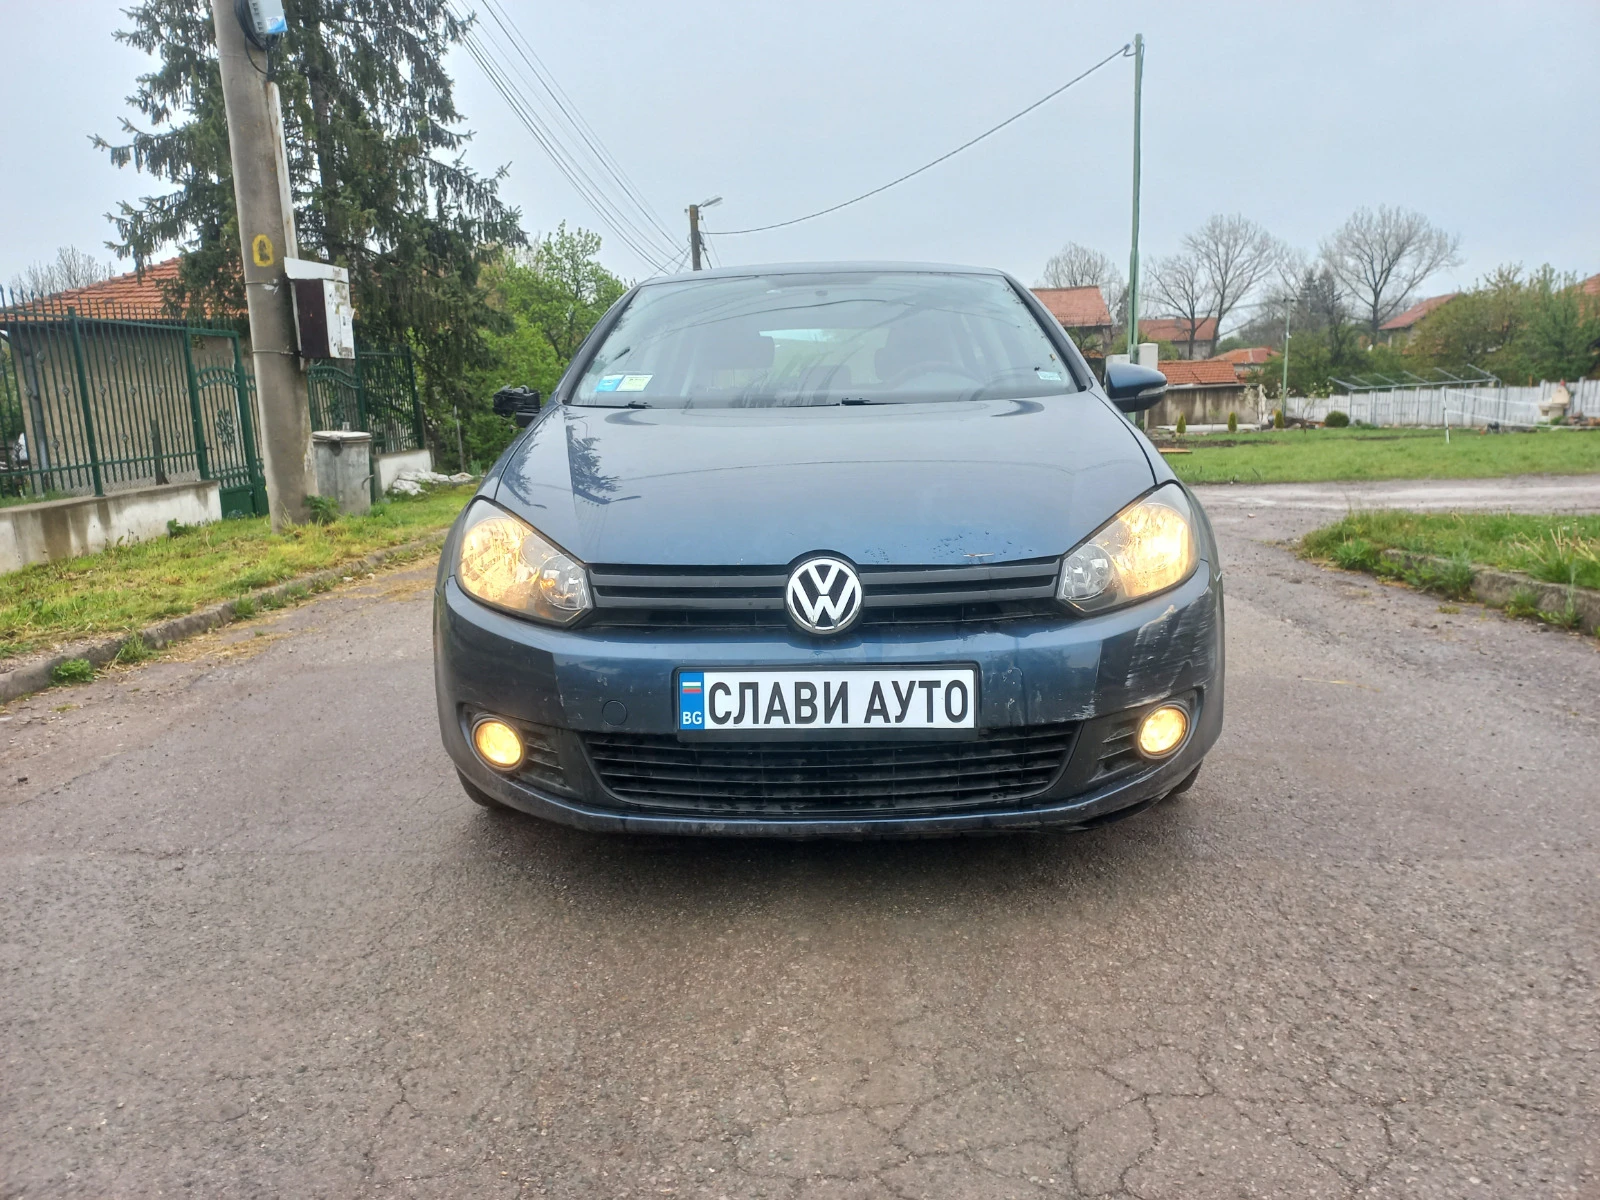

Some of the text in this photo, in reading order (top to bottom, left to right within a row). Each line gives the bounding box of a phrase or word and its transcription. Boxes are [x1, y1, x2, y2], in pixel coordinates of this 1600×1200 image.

[788, 559, 861, 630] VW
[682, 711, 703, 725] BG
[708, 680, 969, 725] СЛАВИ АУТО
